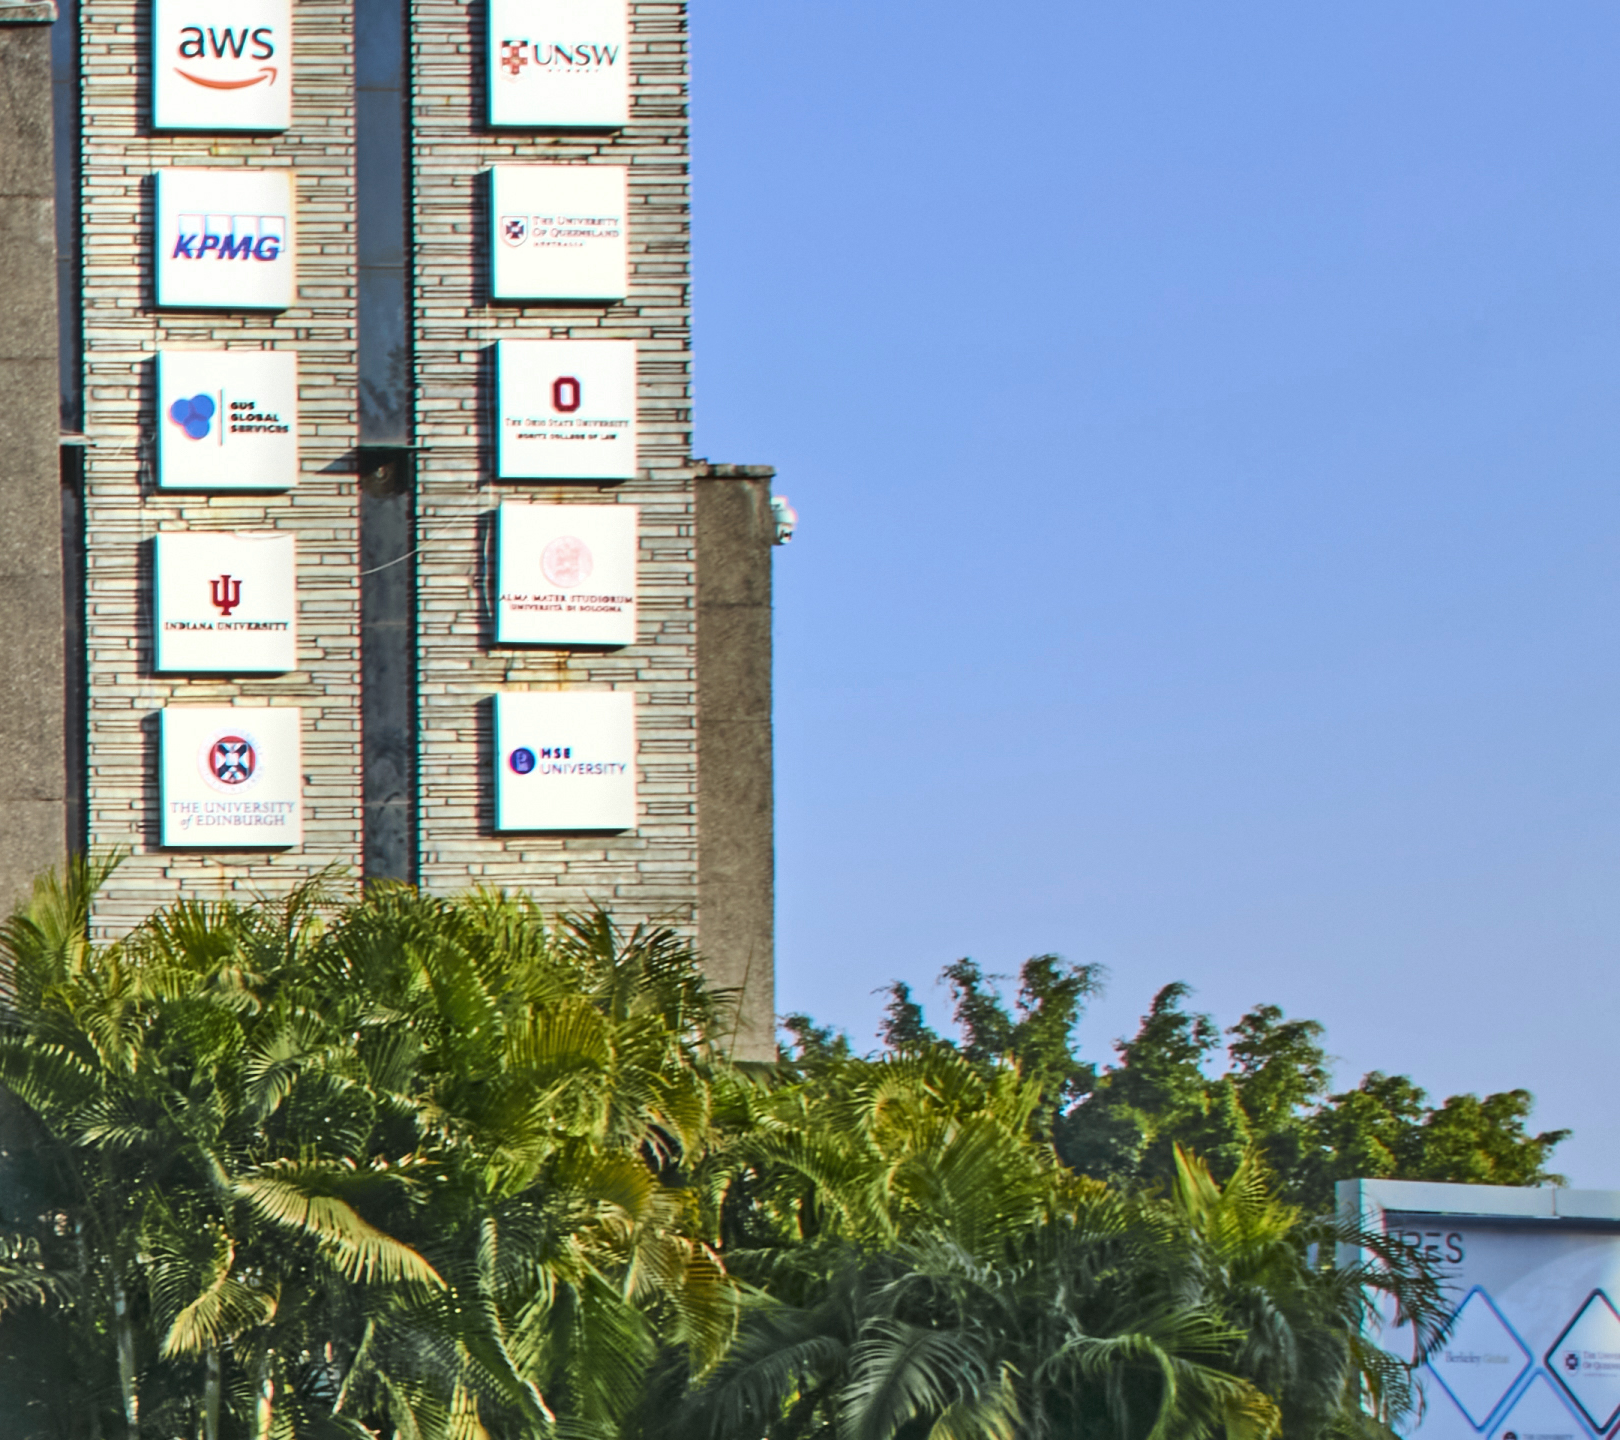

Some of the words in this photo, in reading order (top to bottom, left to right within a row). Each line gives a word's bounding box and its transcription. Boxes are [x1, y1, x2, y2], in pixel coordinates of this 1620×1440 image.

[178, 26, 274, 60] aws
[532, 44, 618, 66] UNSW
[171, 233, 281, 261] KPMG
[230, 401, 255, 410] GUS
[230, 413, 279, 422] GLOBAL
[548, 418, 573, 427] STATE
[230, 424, 289, 434] SERVICES
[532, 594, 566, 602] MATER
[571, 594, 633, 603] STUDIORUM
[579, 605, 622, 613] BOLOGNA
[164, 622, 213, 630] INDIANA
[217, 622, 288, 631] UNIVERSITY
[541, 747, 571, 759] HSE
[541, 763, 625, 775] UNIVERSITY
[170, 802, 199, 813] THE
[204, 802, 295, 813] UNIVERSITY
[180, 814, 193, 830] of
[196, 814, 285, 826] EDINBURGH
